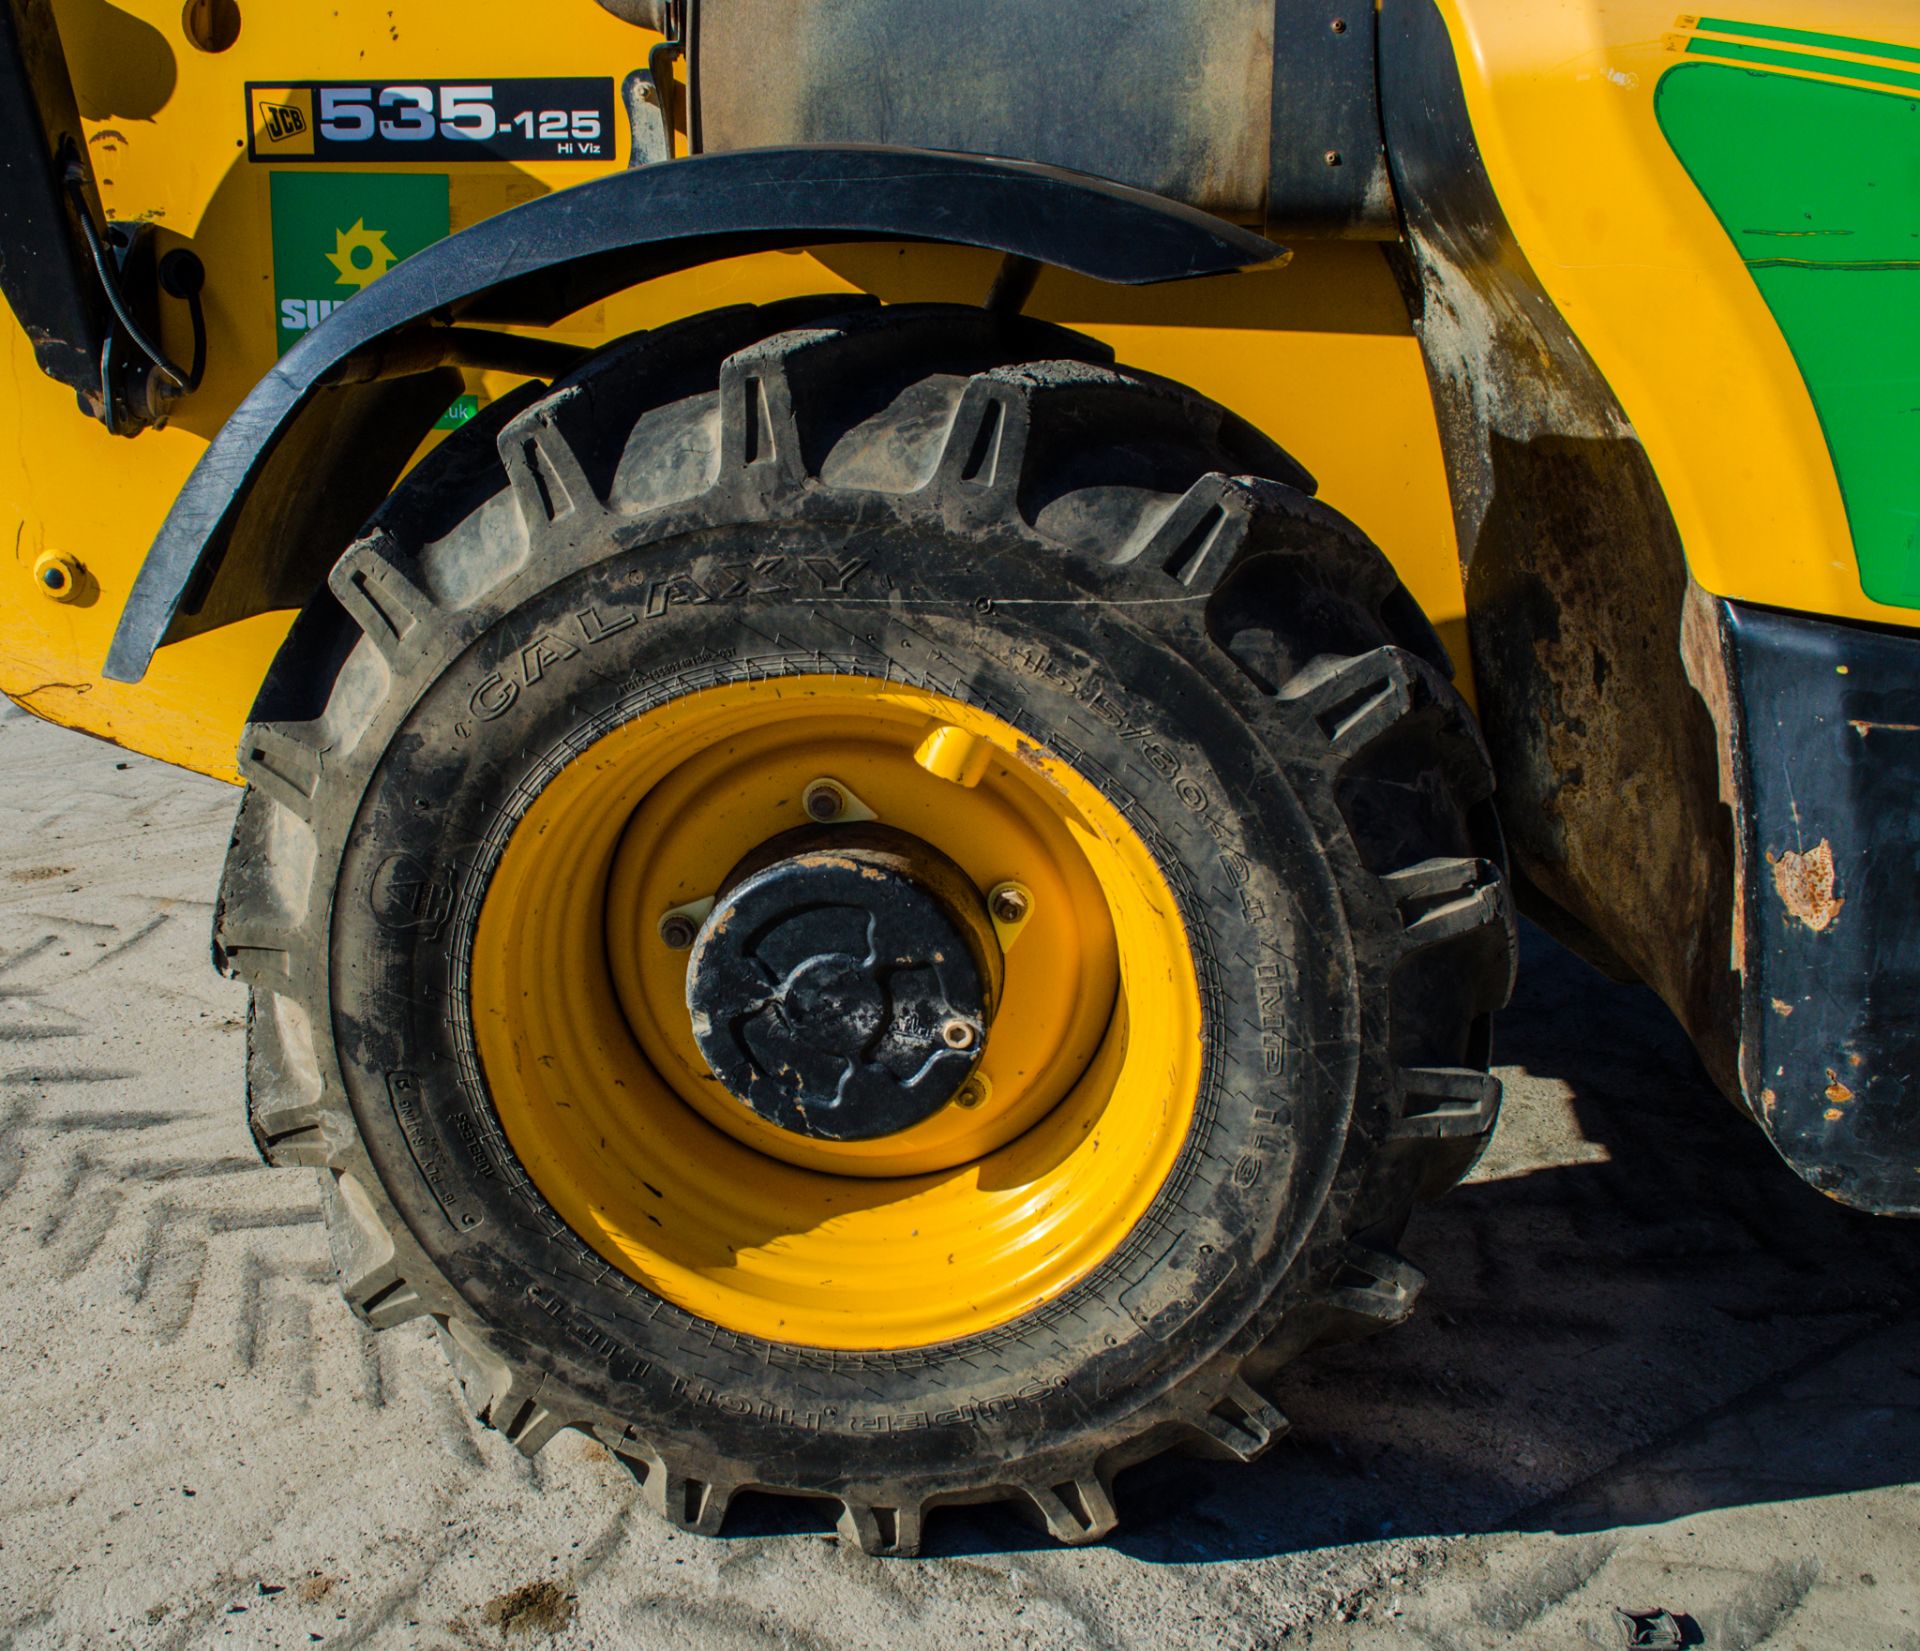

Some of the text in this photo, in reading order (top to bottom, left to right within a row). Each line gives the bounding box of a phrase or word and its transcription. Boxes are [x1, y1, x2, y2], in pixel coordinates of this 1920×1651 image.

[268, 105, 306, 133] JCB
[557, 143, 600, 154] Hi Viz
[469, 556, 871, 722] GALAXY
[455, 1111, 496, 1180] TUBELESS
[850, 1378, 1056, 1432] SUPER
